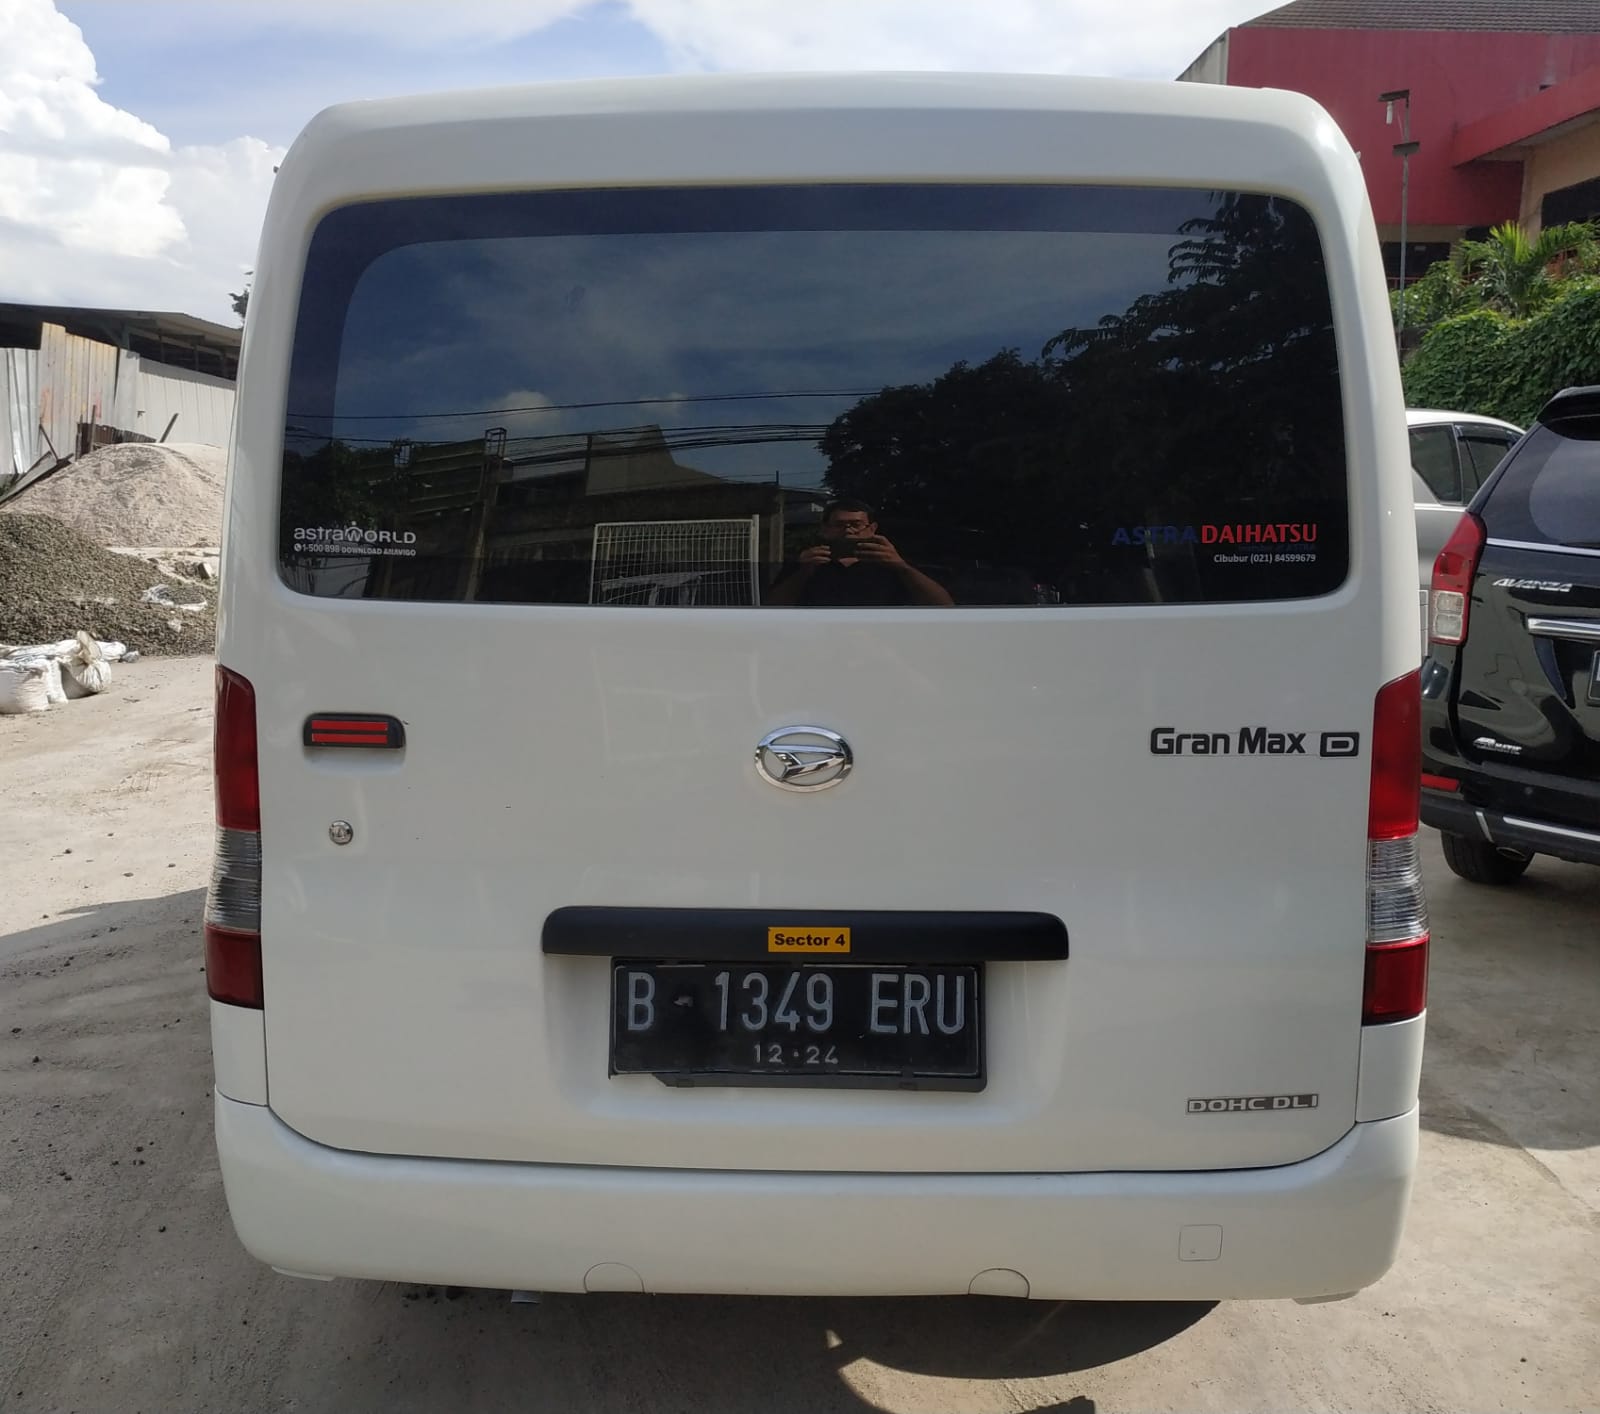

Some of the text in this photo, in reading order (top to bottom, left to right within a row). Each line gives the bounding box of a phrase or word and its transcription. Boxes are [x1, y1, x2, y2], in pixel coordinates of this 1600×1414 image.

[1201, 523, 1318, 544] DAIHATSU
[1213, 553, 1317, 564] Cibubur (021) 84599679
[1492, 577, 1573, 593] AVANZA
[1150, 727, 1231, 755] Gran
[1237, 727, 1307, 754] Max
[773, 933, 846, 947] Sector 4
[626, 971, 966, 1036] B 1349 ERU
[1188, 1095, 1318, 1113] DOHC DLI
